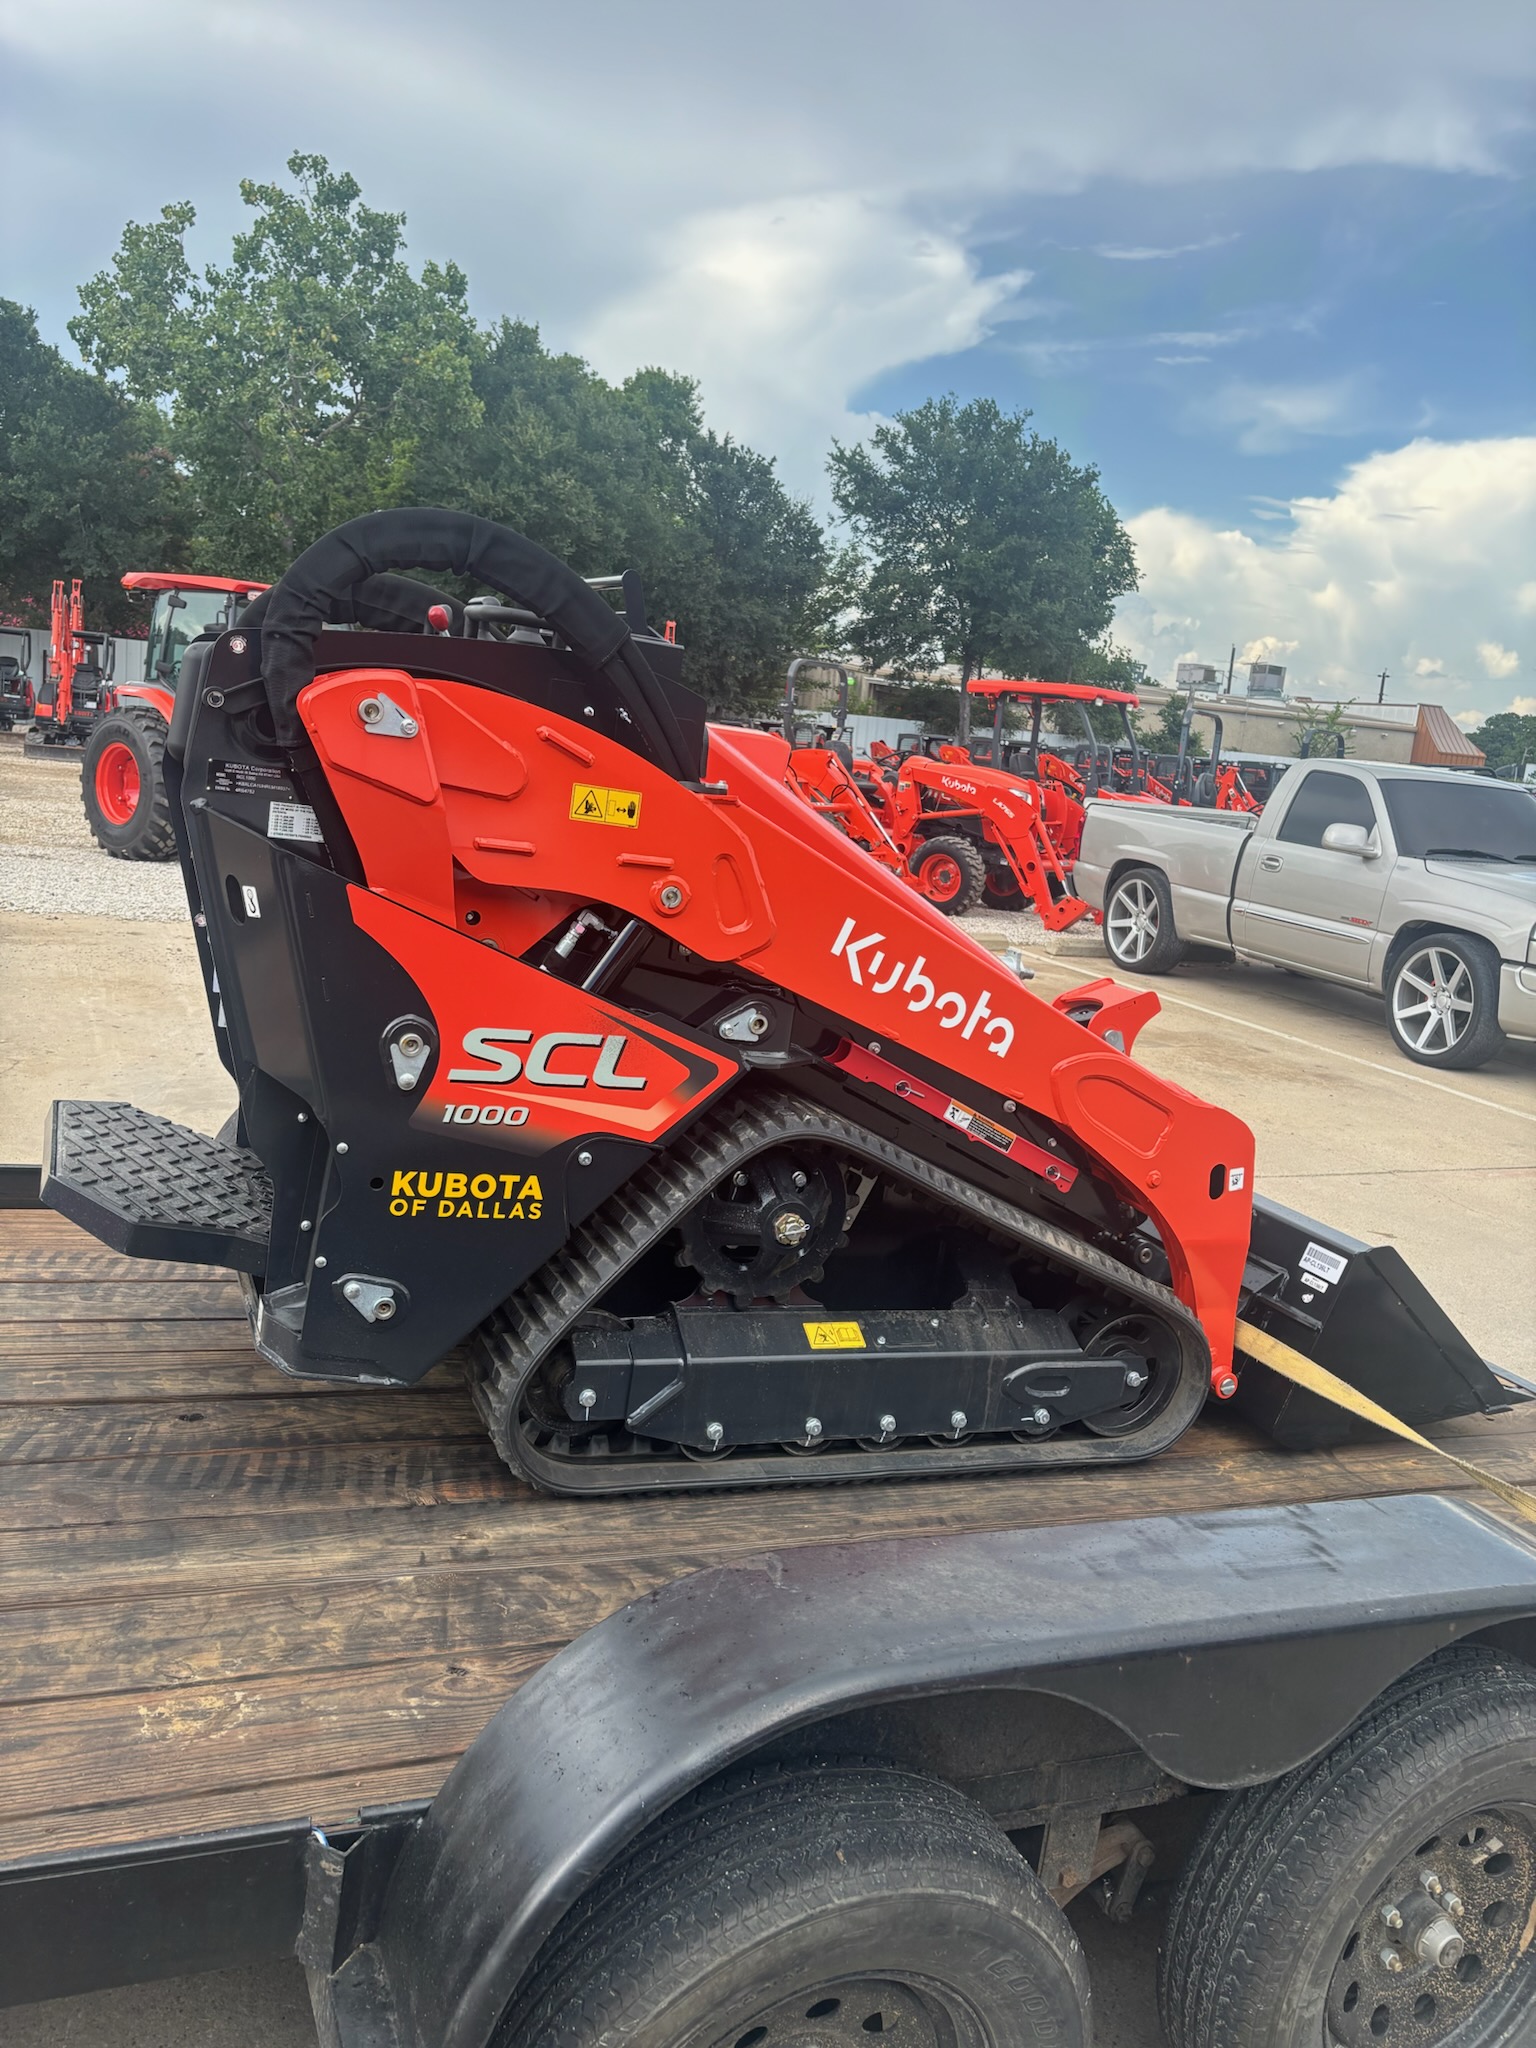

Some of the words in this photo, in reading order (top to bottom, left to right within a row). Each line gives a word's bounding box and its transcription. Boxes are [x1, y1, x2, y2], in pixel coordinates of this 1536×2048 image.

[225, 763, 250, 771] KUBOTA
[251, 765, 281, 774] Corporation
[942, 776, 977, 795] Kubota
[830, 917, 1014, 1058] Kubota
[447, 1027, 647, 1090] SCL
[442, 1104, 530, 1126] 1000
[391, 1170, 543, 1200] KUBOTA
[389, 1198, 427, 1216] OF
[437, 1200, 543, 1220] DALLAS
[984, 1956, 1058, 2048] GOOD
